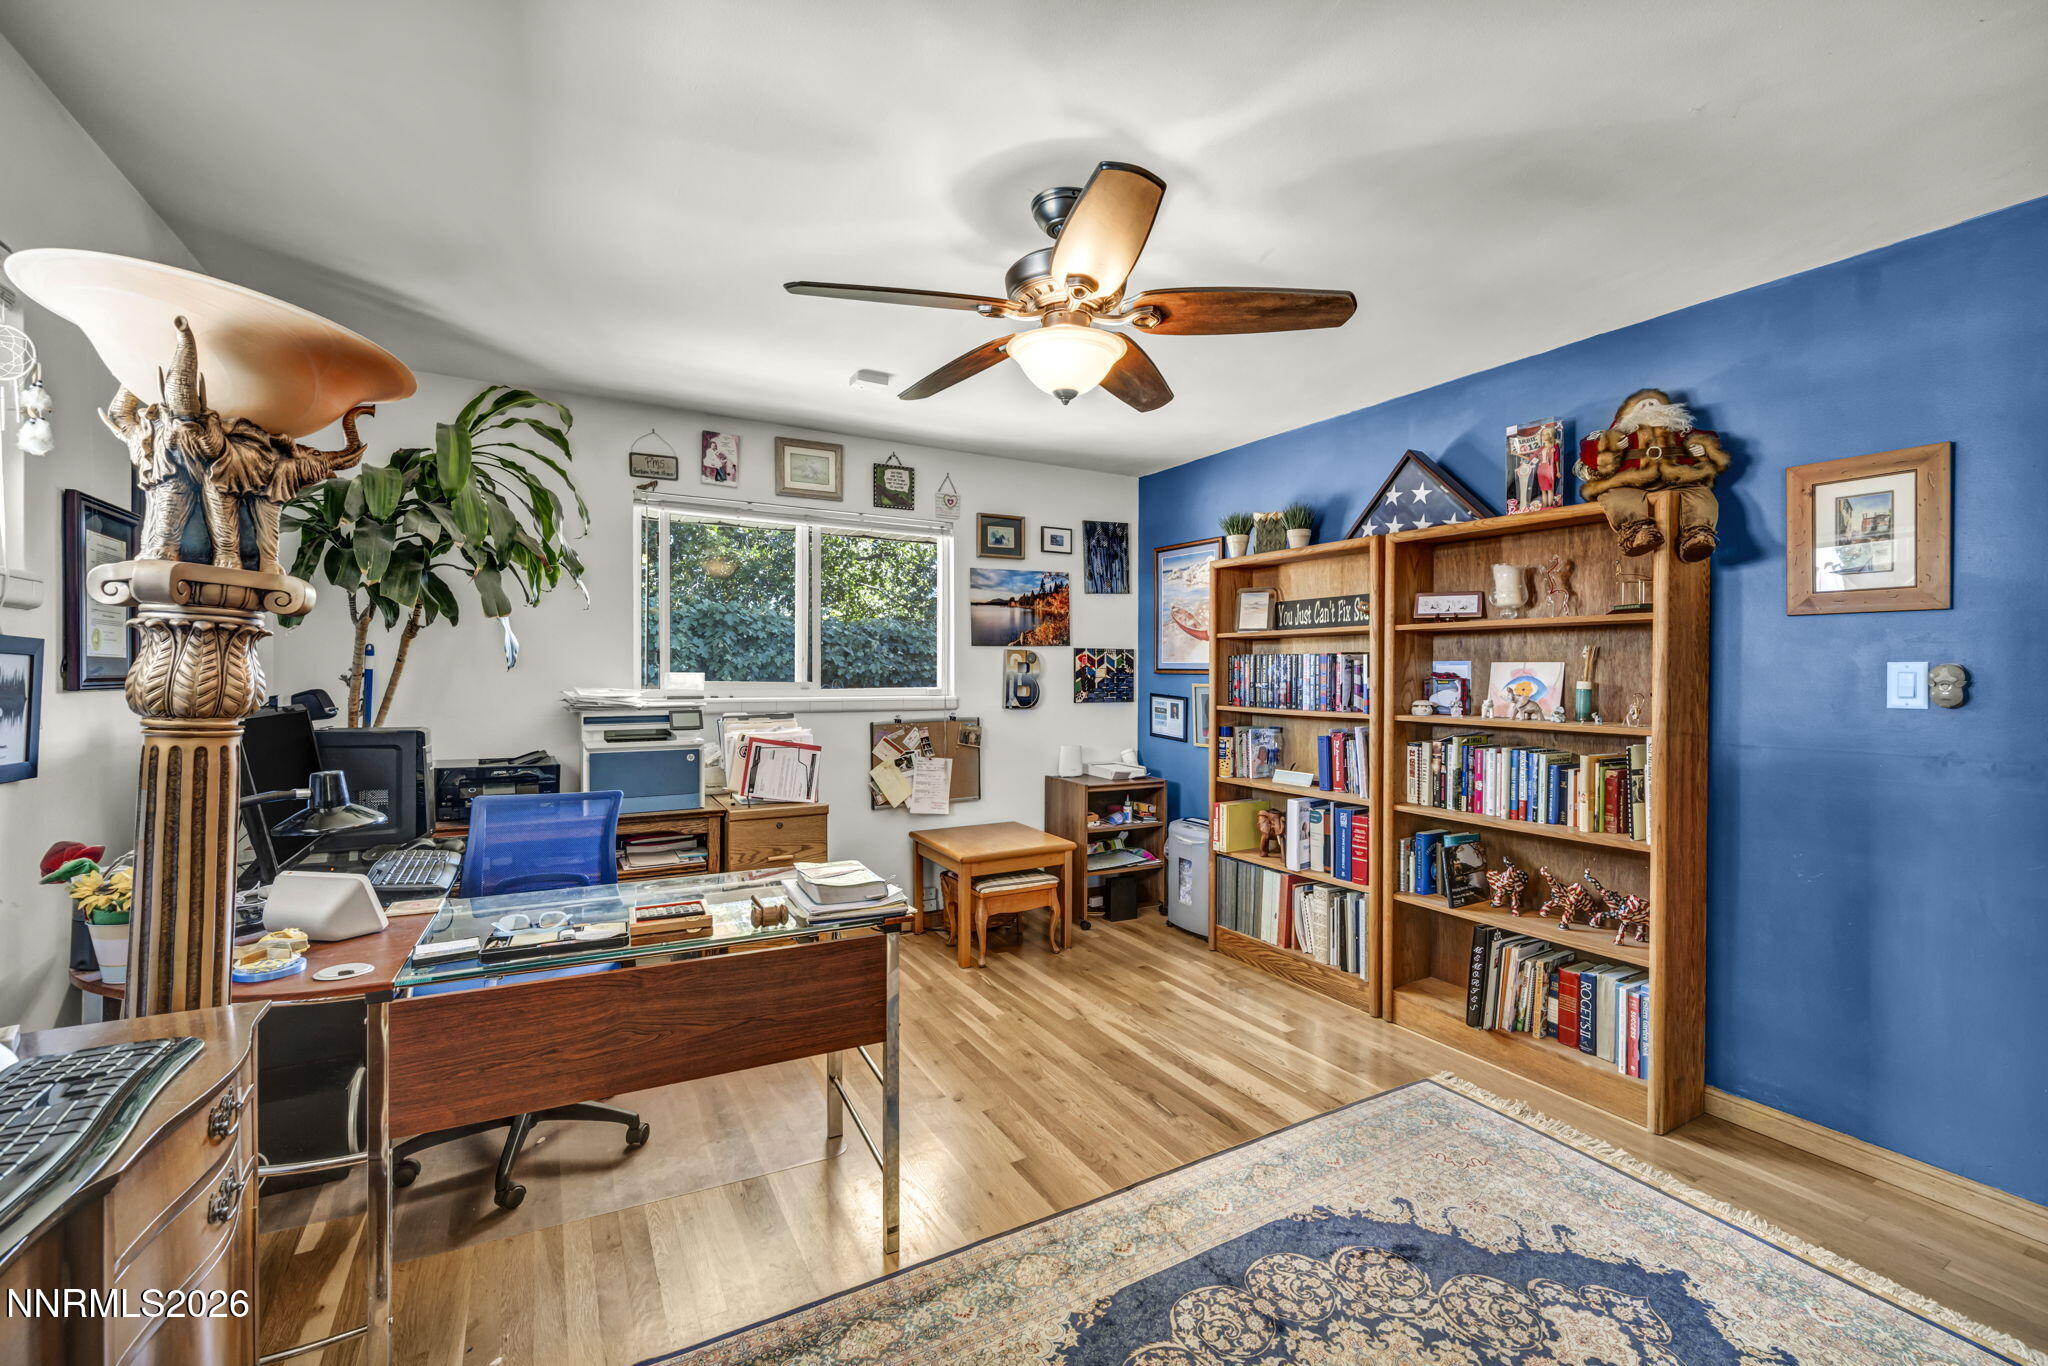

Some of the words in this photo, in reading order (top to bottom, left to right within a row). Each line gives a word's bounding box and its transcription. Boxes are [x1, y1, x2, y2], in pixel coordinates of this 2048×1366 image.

[1278, 604, 1293, 627] You
[1294, 603, 1312, 626] Just
[1313, 600, 1336, 624] Can't
[1337, 599, 1352, 622] Fix
[1580, 980, 1592, 1030] ROGET'S
